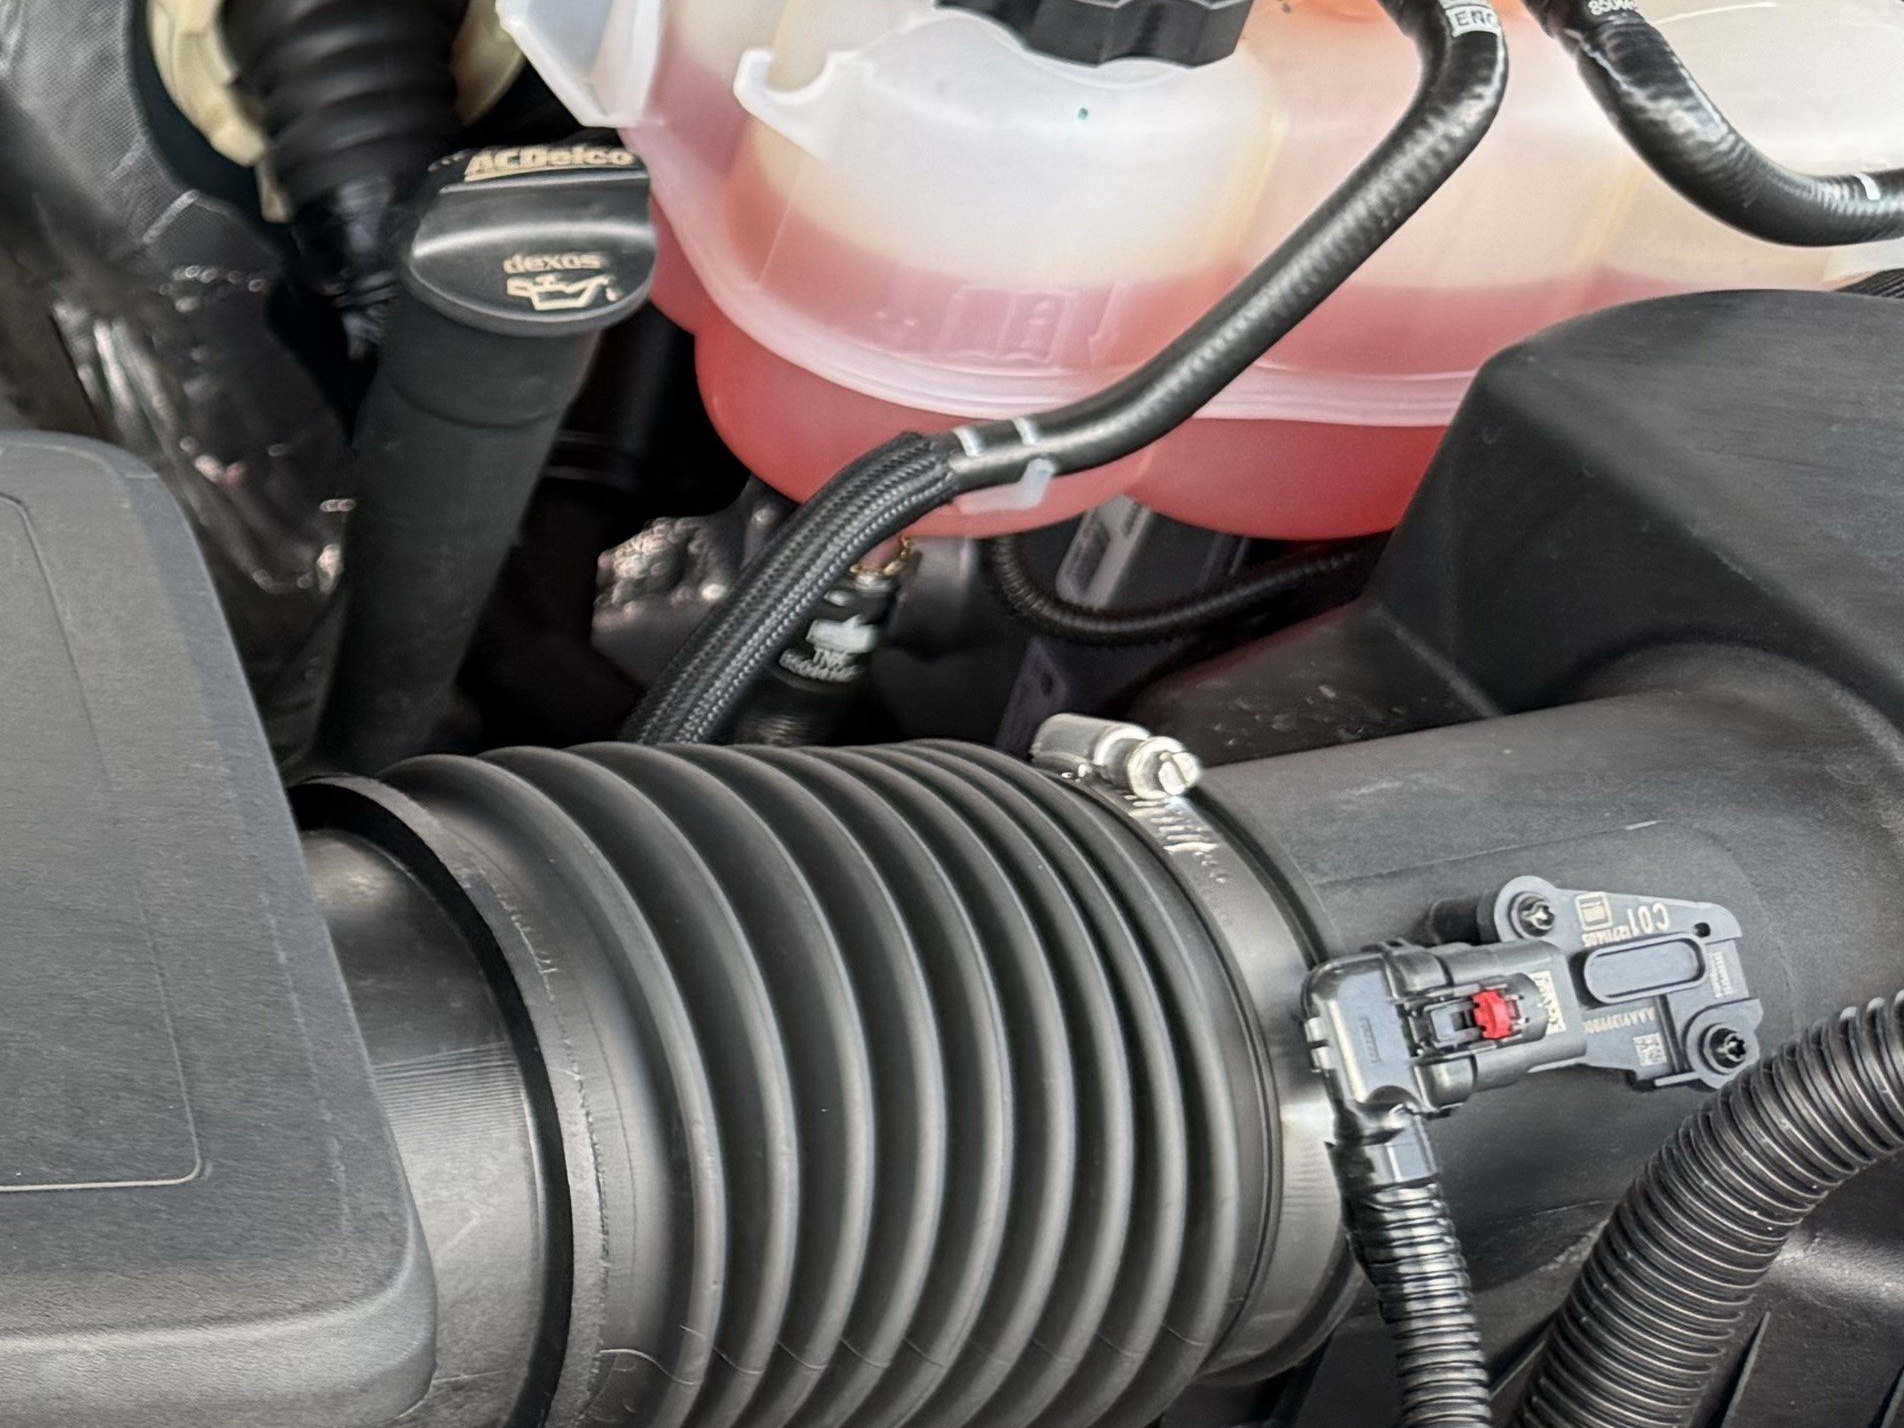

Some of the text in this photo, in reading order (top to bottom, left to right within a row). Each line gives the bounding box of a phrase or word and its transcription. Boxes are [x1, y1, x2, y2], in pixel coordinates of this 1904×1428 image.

[464, 145, 636, 181] ACDelco
[503, 253, 610, 274] dexos
[1625, 902, 1670, 938] C01
